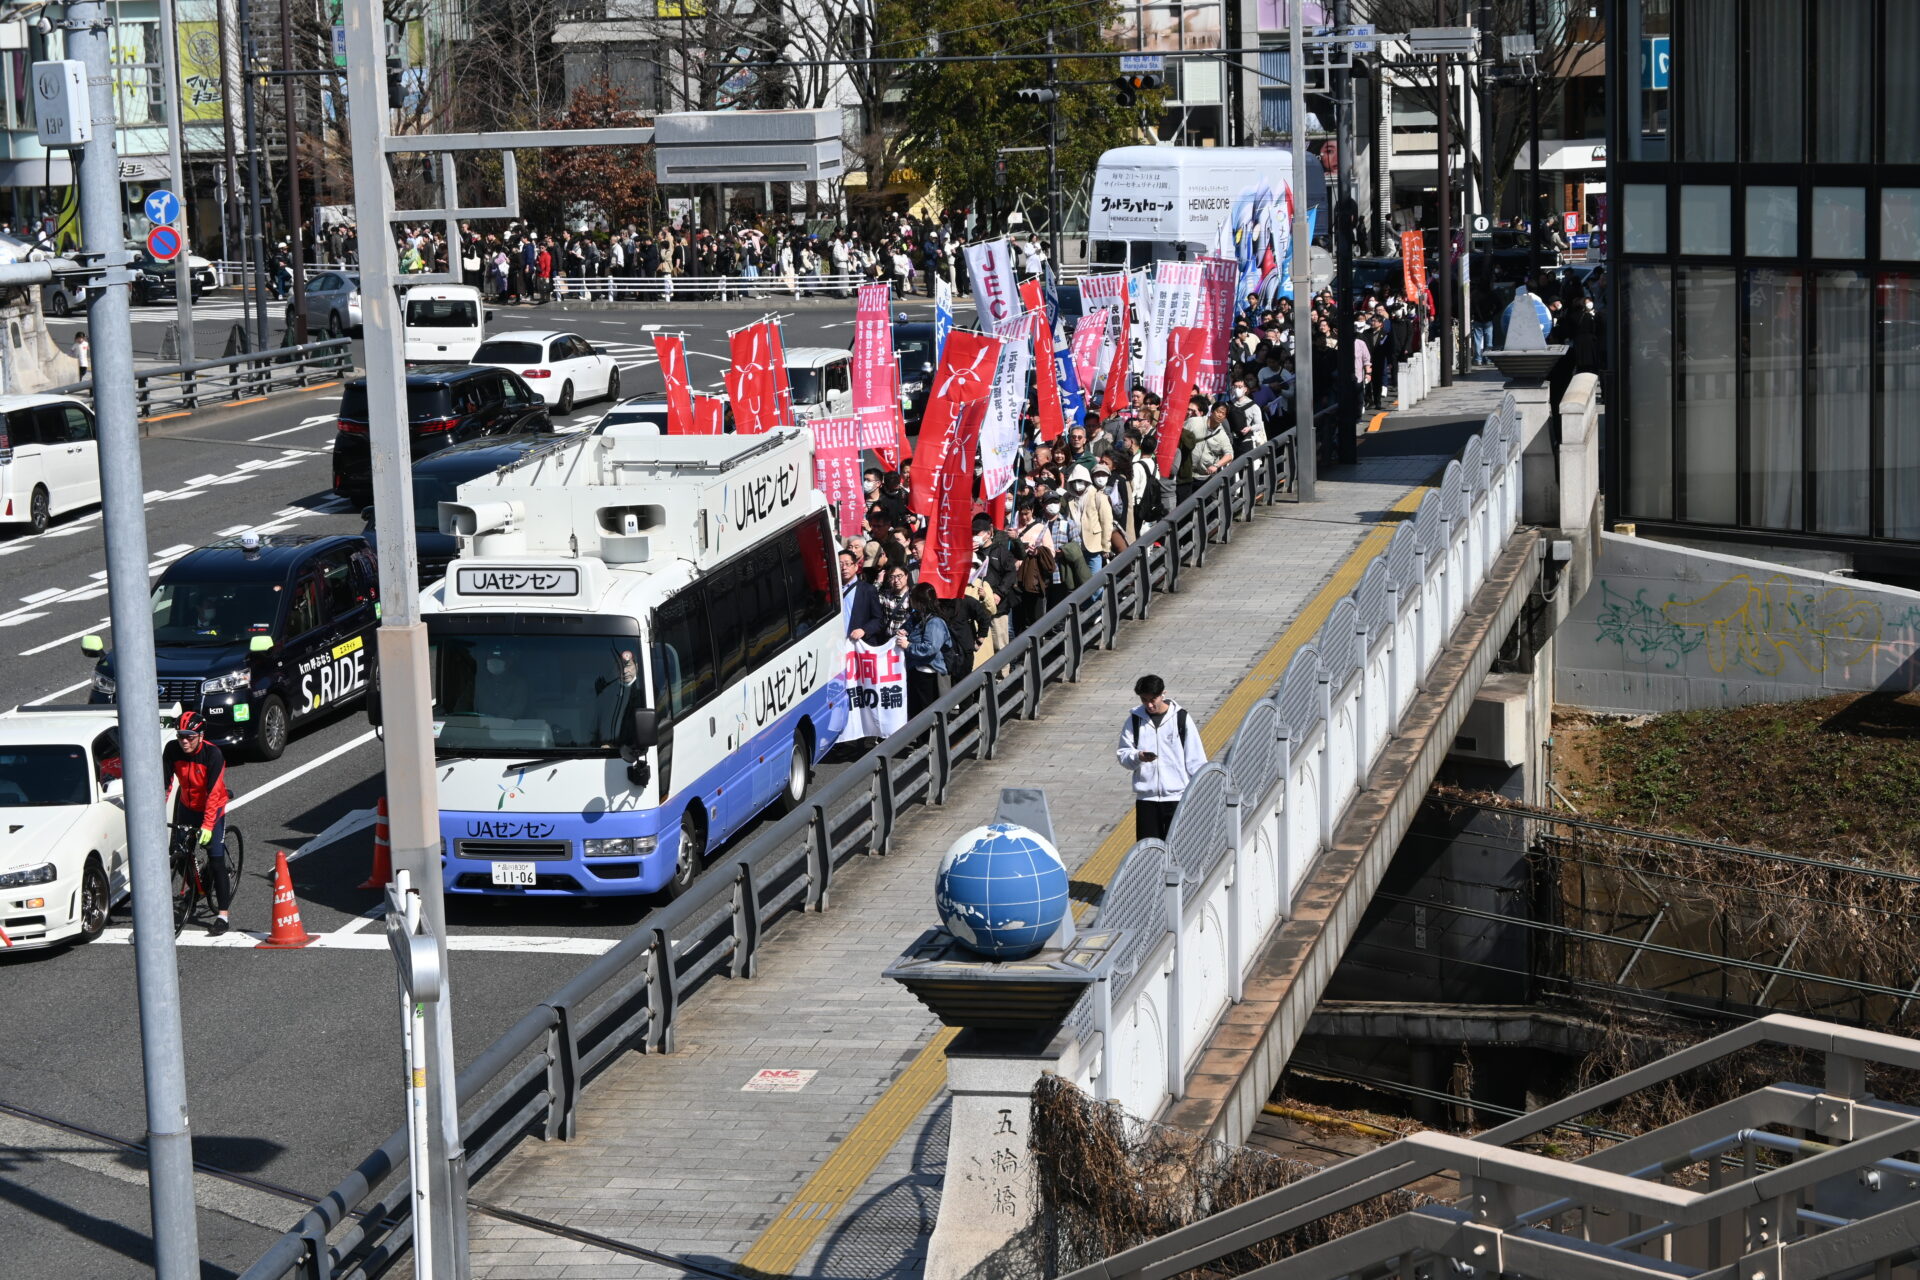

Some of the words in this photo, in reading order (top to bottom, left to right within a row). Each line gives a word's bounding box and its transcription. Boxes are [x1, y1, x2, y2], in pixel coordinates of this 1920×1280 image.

[1354, 41, 1369, 49] Sta.
[1188, 199, 1215, 210] HENNGE
[982, 250, 1008, 320] JEC
[734, 462, 799, 531] UAゼンセン
[473, 573, 561, 590] UAゼンセン
[754, 648, 818, 727] UAゼンセン
[209, 707, 224, 715] km
[467, 821, 555, 838] UAゼンセン
[503, 871, 534, 884] 11-06
[990, 1109, 1018, 1217] 五輪橋
